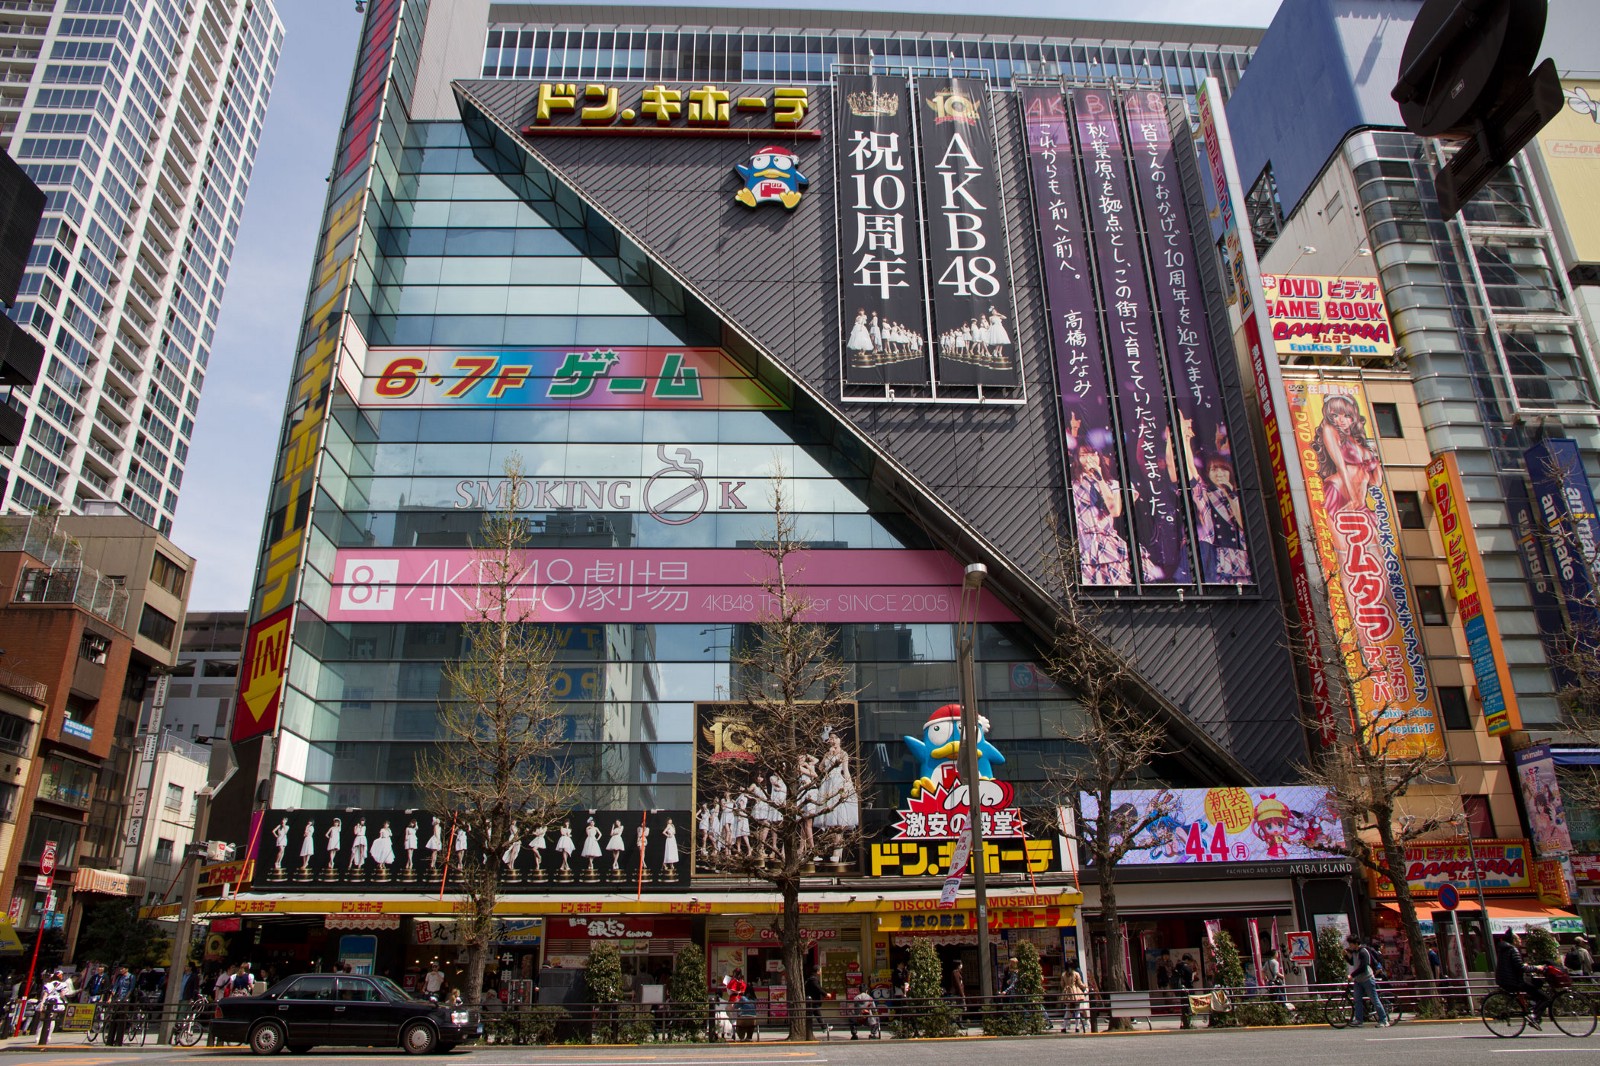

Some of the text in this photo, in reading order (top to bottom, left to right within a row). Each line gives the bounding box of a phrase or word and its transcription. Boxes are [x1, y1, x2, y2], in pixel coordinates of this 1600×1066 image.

[848, 130, 909, 299] 祝10周年
[935, 133, 999, 297] AKB48
[1279, 279, 1322, 298] DVD
[1327, 280, 1378, 300] ビデオ
[1325, 301, 1385, 321] BOOK
[1064, 309, 1092, 398] 高橋みなみ
[545, 348, 703, 400] ゲーム
[1295, 411, 1312, 442] DVD
[1303, 449, 1319, 472] CD
[453, 479, 632, 510] SMOKING
[1435, 483, 1458, 534] DVD
[1541, 493, 1574, 581] animate
[1335, 511, 1394, 642] ラムタラ
[1448, 535, 1468, 589] ビデオ
[347, 565, 390, 604] 8F
[701, 594, 754, 612] AKB48
[837, 594, 897, 612] SINCE
[901, 594, 948, 612] 2005
[252, 634, 284, 680] IN
[1208, 787, 1247, 811] 新装
[1213, 809, 1251, 830] 開店
[1289, 864, 1317, 874] AKIBA
[1319, 863, 1352, 873] ISLAND
[587, 918, 625, 937] 銀だこ
[800, 928, 836, 940] Crepes
[501, 952, 514, 983] 牛串
